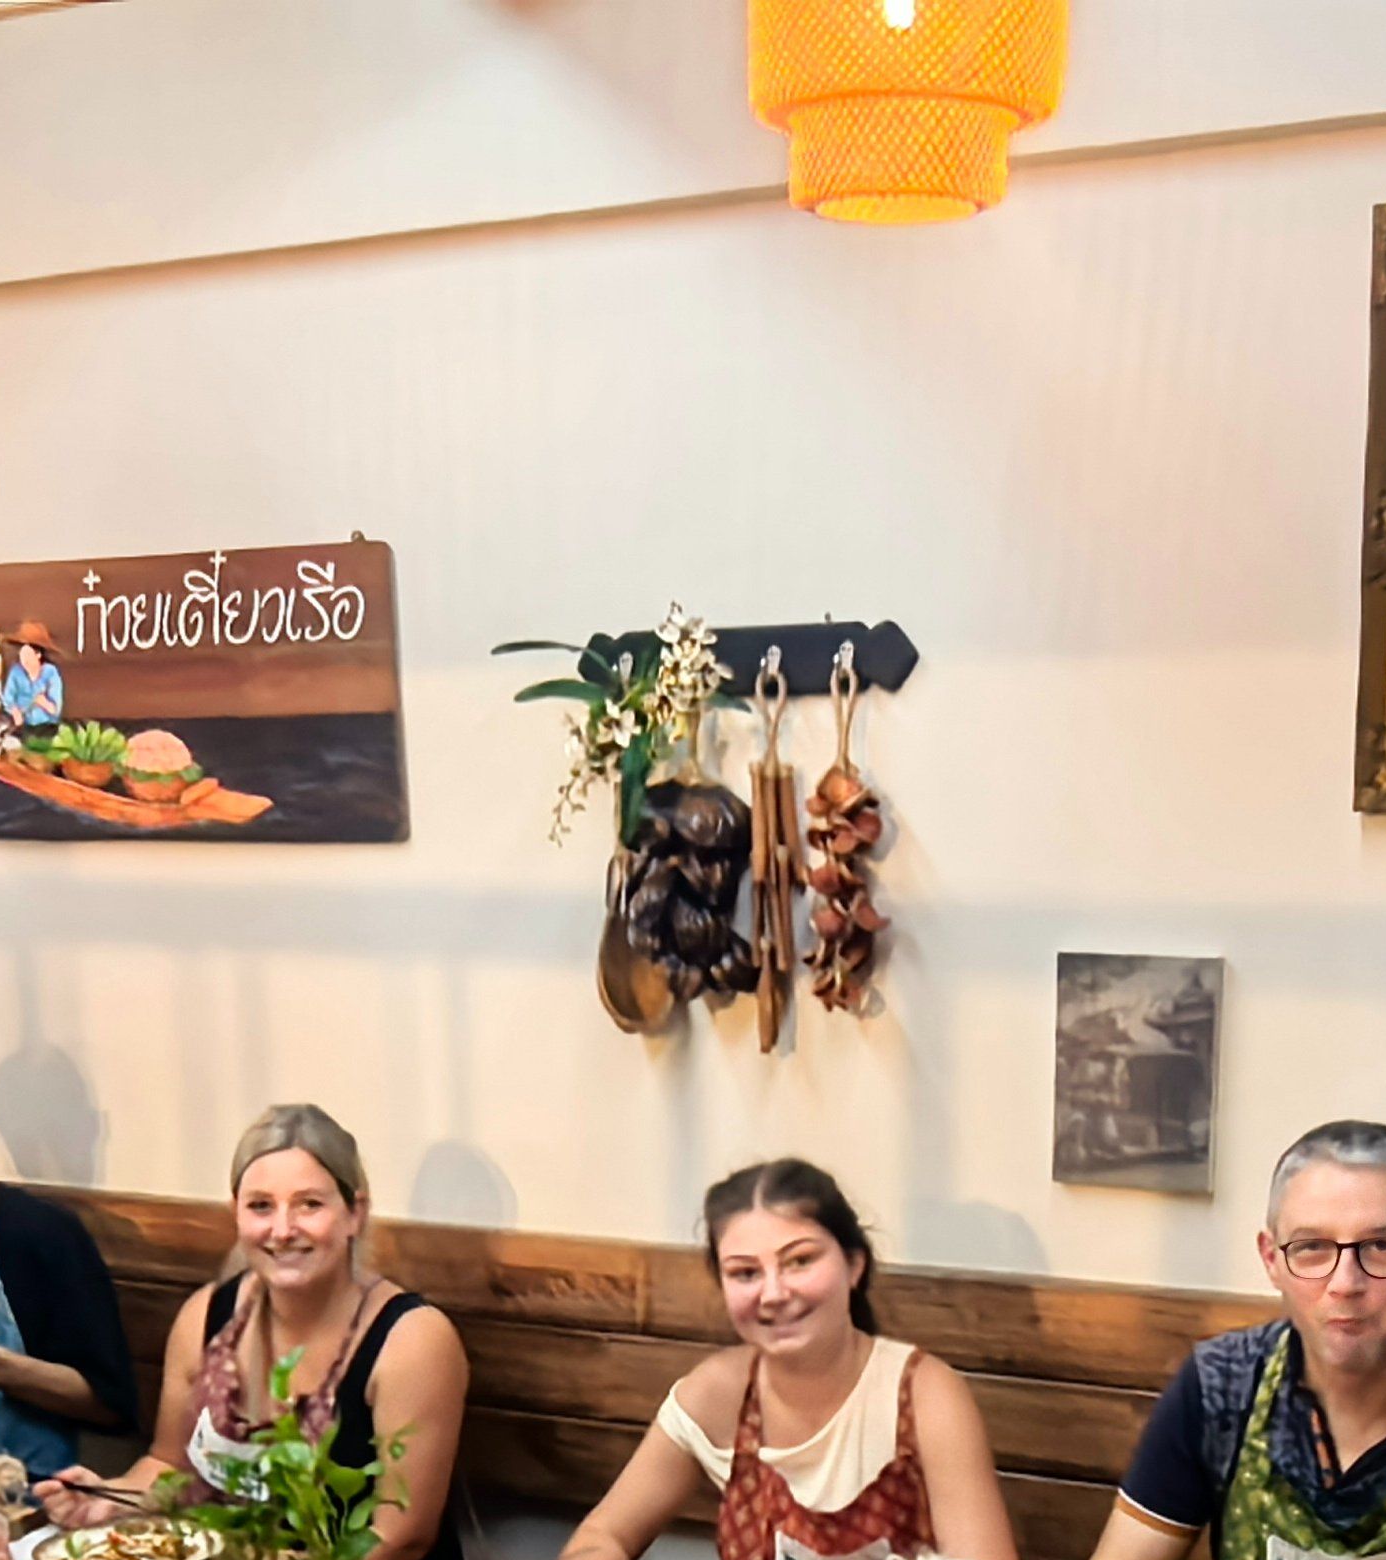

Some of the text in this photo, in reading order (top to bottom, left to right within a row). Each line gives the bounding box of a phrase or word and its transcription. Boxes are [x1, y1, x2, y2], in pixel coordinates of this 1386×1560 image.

[76, 548, 365, 653] ก๋วยเตี๋ยวเรือ
